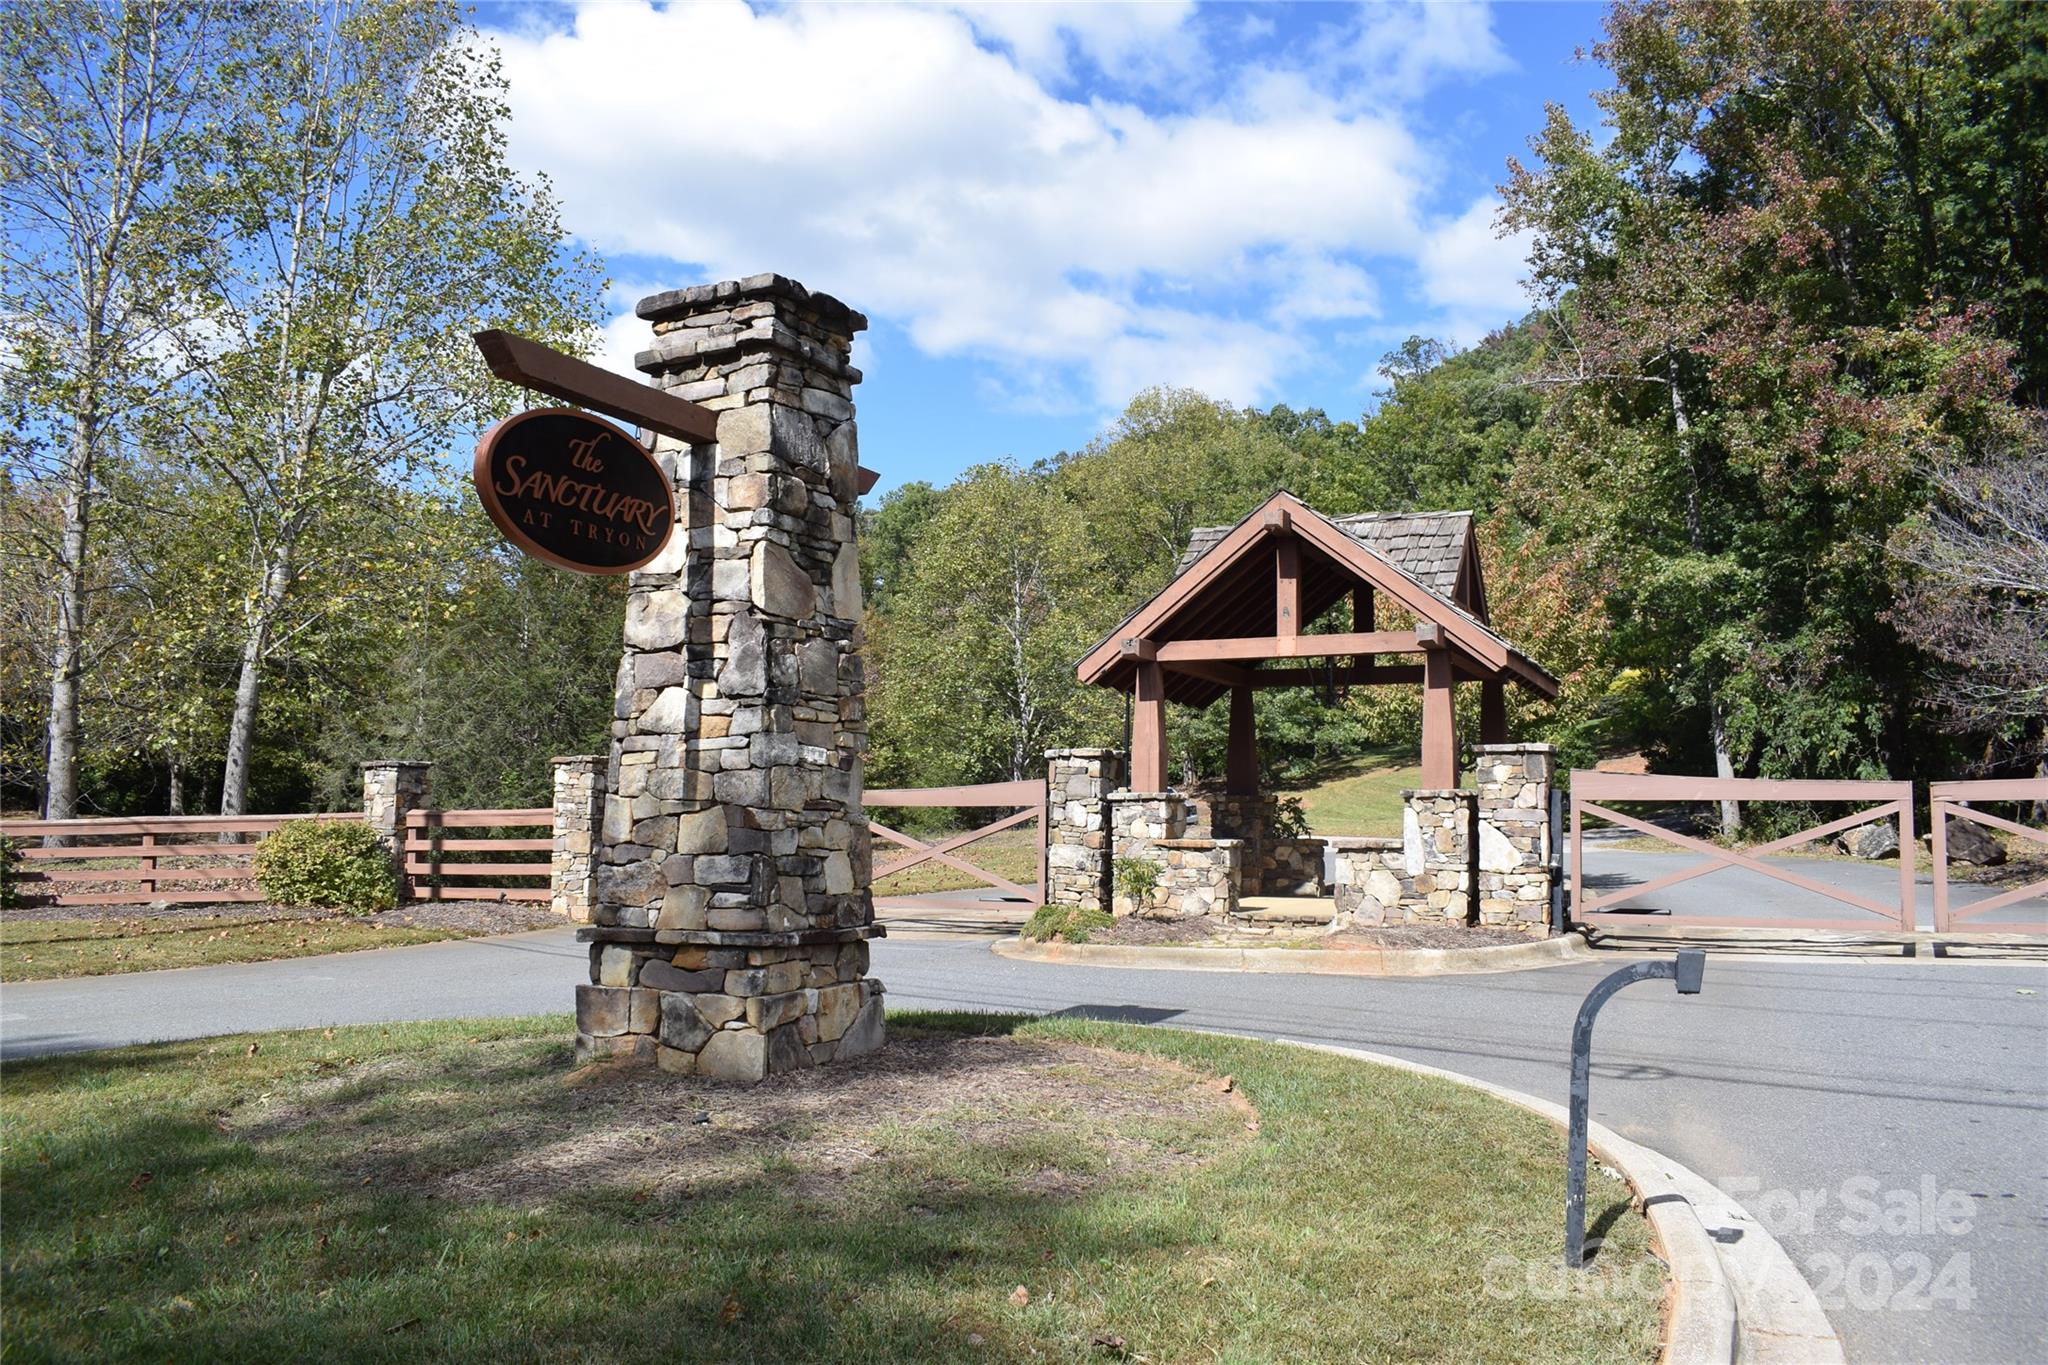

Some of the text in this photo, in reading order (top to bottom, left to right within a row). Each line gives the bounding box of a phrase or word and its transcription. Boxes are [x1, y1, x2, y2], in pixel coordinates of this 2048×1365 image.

[568, 432, 612, 474] The
[495, 455, 669, 536] SANCTUARY
[523, 508, 648, 550] AT TRYON
